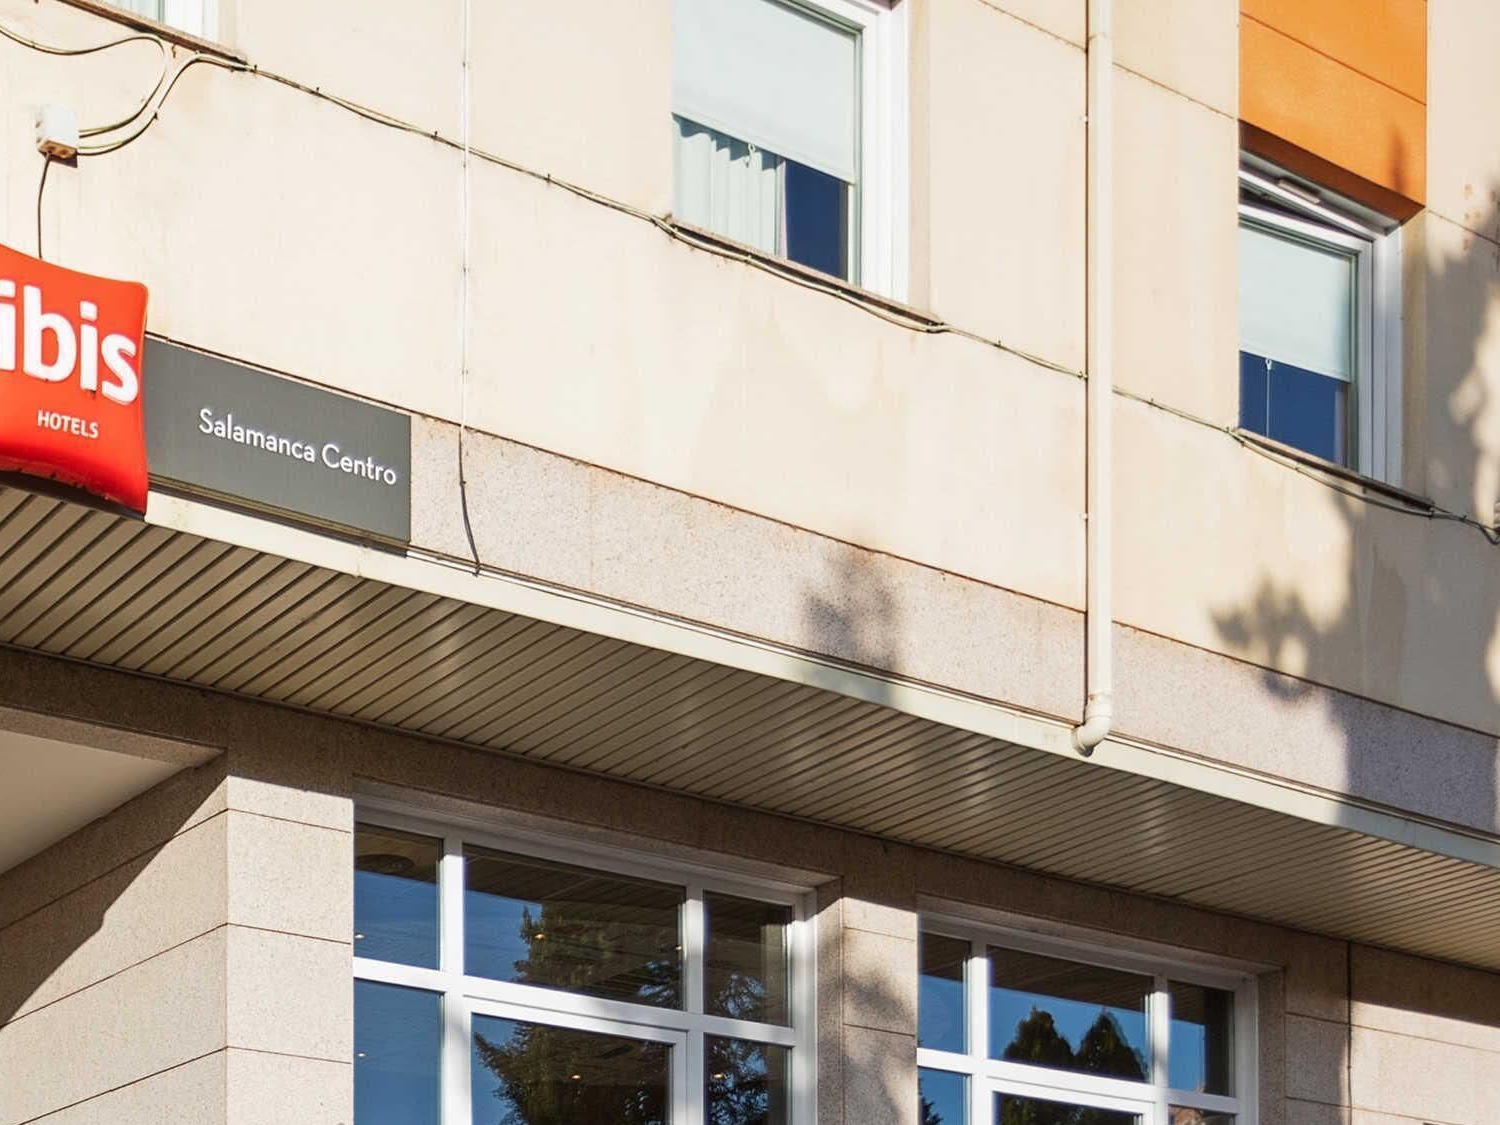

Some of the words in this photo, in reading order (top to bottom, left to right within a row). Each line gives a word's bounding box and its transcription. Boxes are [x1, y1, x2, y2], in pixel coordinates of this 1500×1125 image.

[36, 408, 99, 439] HOTELS
[198, 407, 316, 463] Salamanca
[321, 443, 398, 486] Centro
